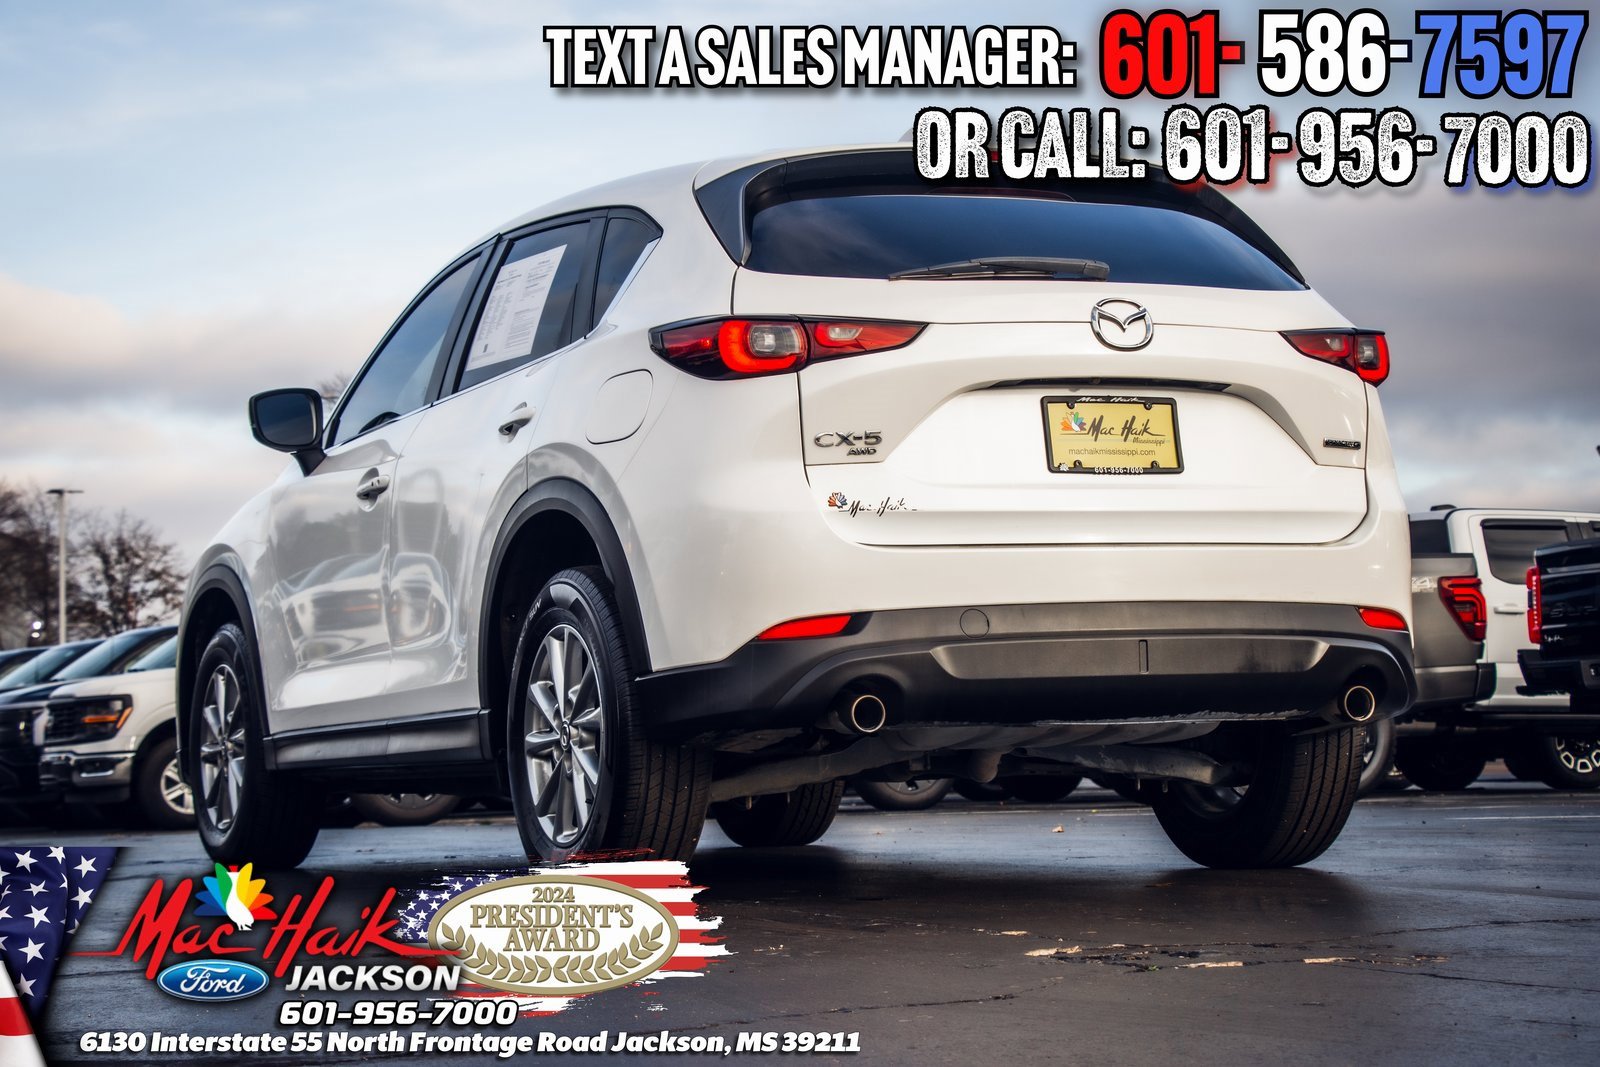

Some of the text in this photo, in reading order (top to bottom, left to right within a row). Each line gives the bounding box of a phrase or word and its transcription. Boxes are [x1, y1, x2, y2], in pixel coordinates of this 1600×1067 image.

[1087, 415, 1165, 442] Mac Haik
[814, 430, 883, 447] CX-5
[1133, 436, 1165, 446] Mississippi
[847, 448, 876, 456] AWD
[1069, 448, 1156, 456] machaikmississippi.com
[1095, 467, 1144, 475] 601-956-7000
